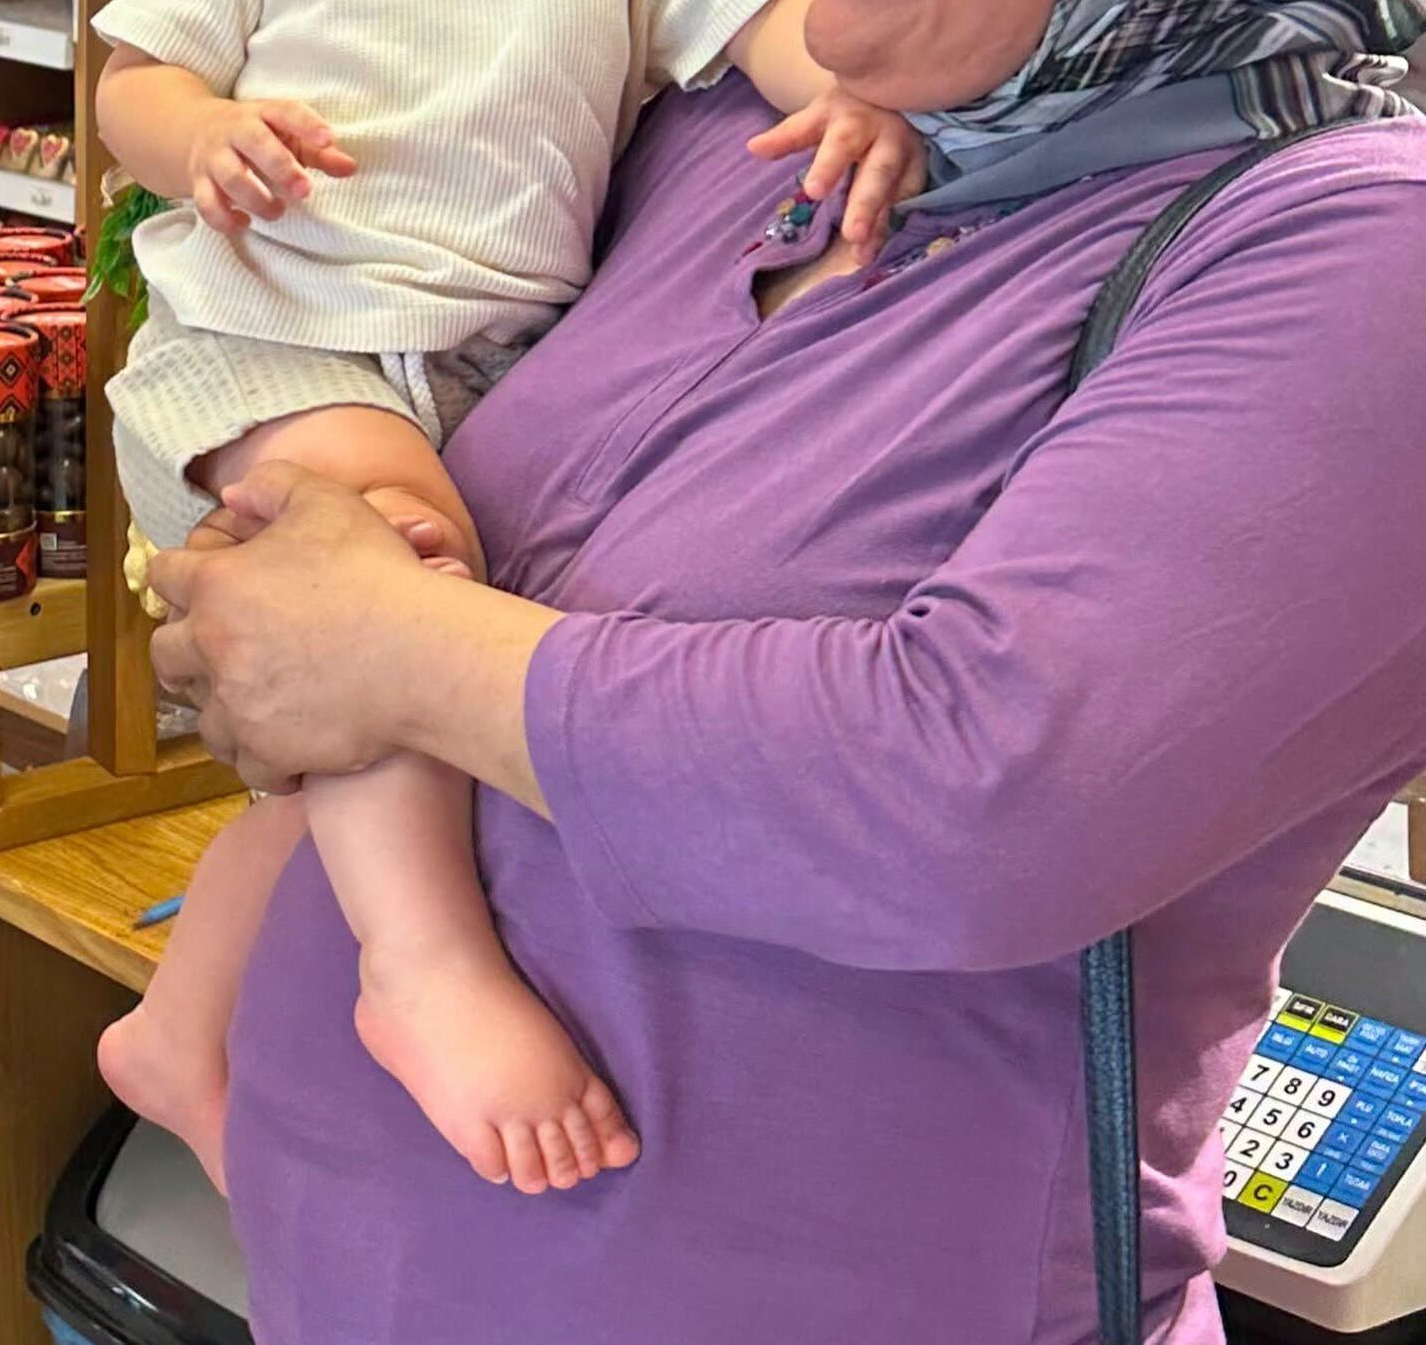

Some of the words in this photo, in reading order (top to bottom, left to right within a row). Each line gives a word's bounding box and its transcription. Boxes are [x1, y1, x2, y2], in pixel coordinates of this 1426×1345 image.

[1251, 1065, 1270, 1081] 7
[1284, 1078, 1302, 1095] 8
[1318, 1090, 1336, 1107] 9
[1230, 1097, 1247, 1113] 4
[1263, 1109, 1282, 1126] 5
[1297, 1122, 1315, 1139] 6
[1240, 1140, 1260, 1158] 2
[1275, 1152, 1294, 1170] 3
[1224, 1170, 1238, 1187] 0
[1253, 1184, 1273, 1201] C
